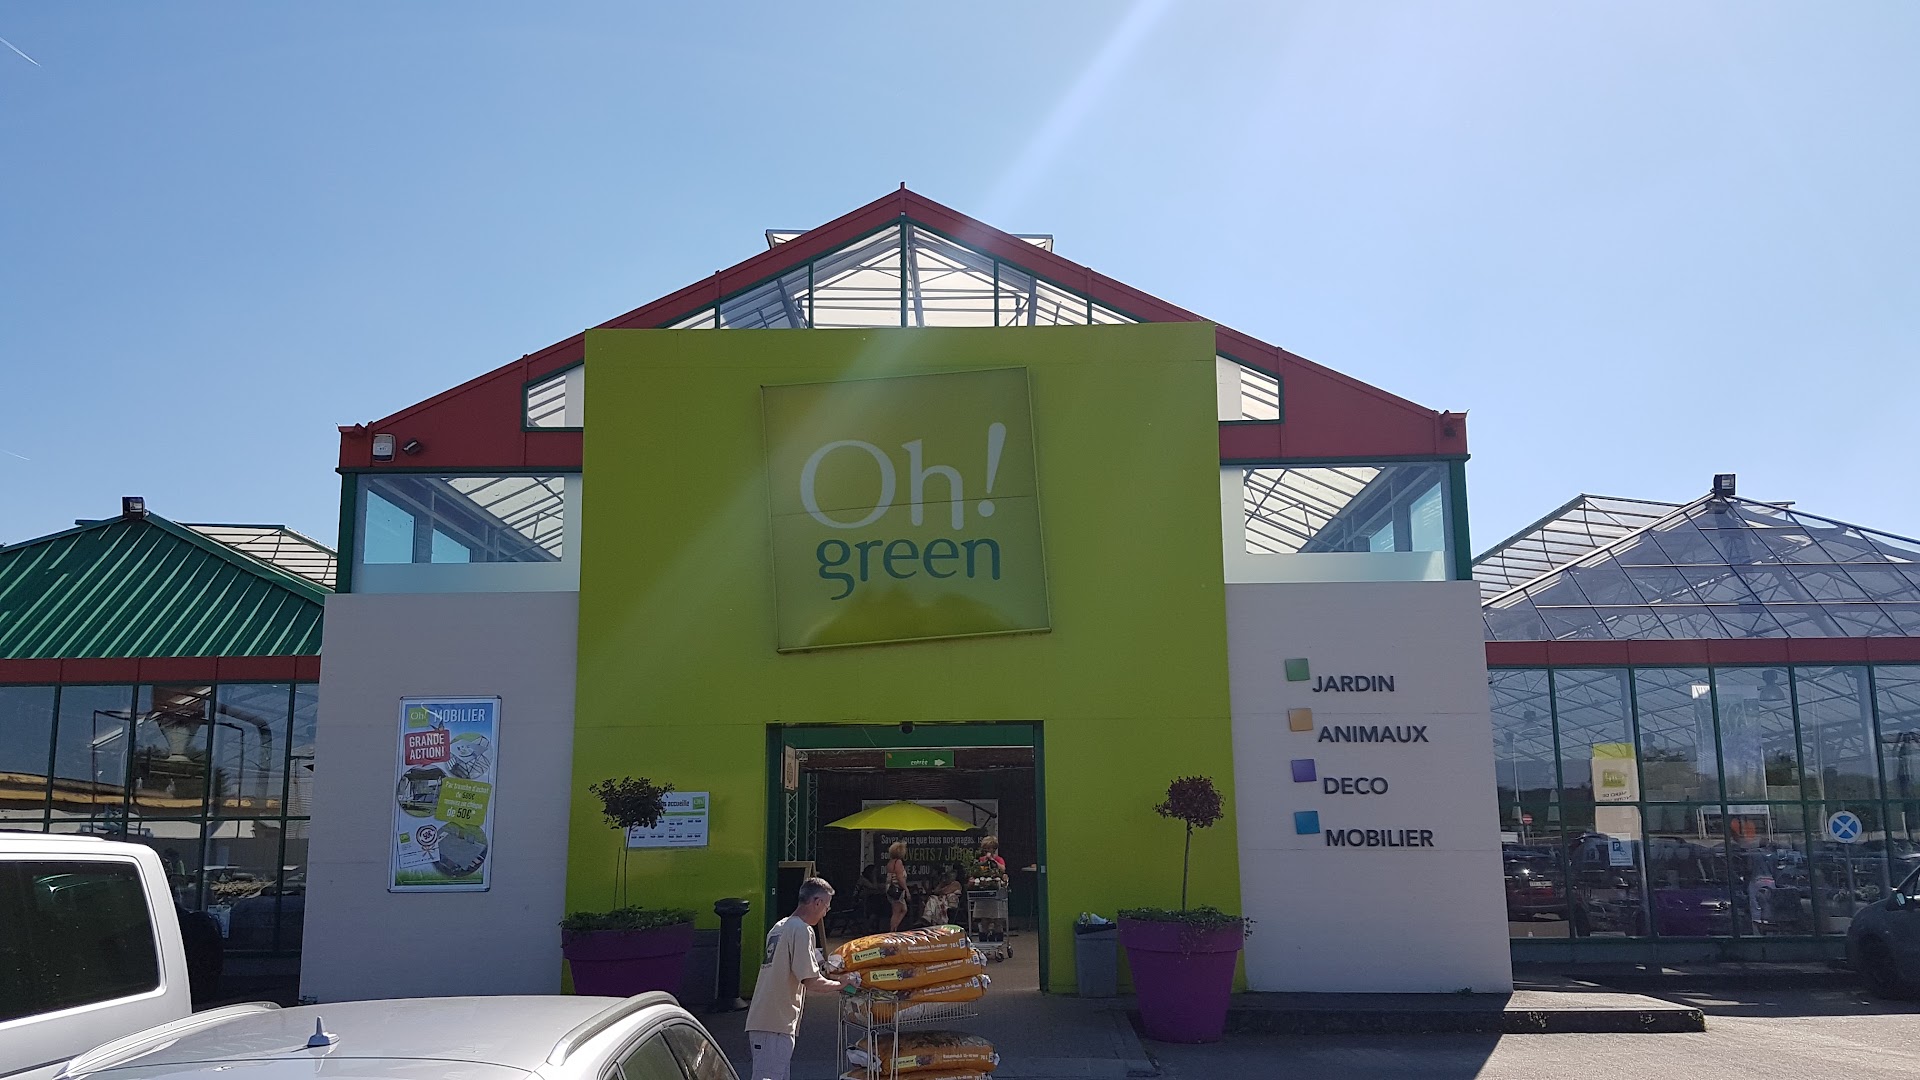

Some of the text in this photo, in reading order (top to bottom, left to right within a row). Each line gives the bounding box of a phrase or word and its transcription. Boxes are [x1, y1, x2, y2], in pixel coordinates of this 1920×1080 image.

[800, 421, 1007, 531] Oh!
[815, 537, 1001, 601] green
[1312, 675, 1395, 693] JARDIN
[410, 708, 486, 723] Oh! MOBILIER
[409, 733, 445, 748] GRANDE
[1318, 725, 1429, 743] ANIMAUX
[409, 746, 445, 760] ACTION!
[1323, 777, 1389, 795] DECO
[916, 836, 927, 846] que
[928, 835, 941, 845] tous
[1326, 829, 1435, 848] MOBILIER
[903, 847, 936, 861] UVERTS
